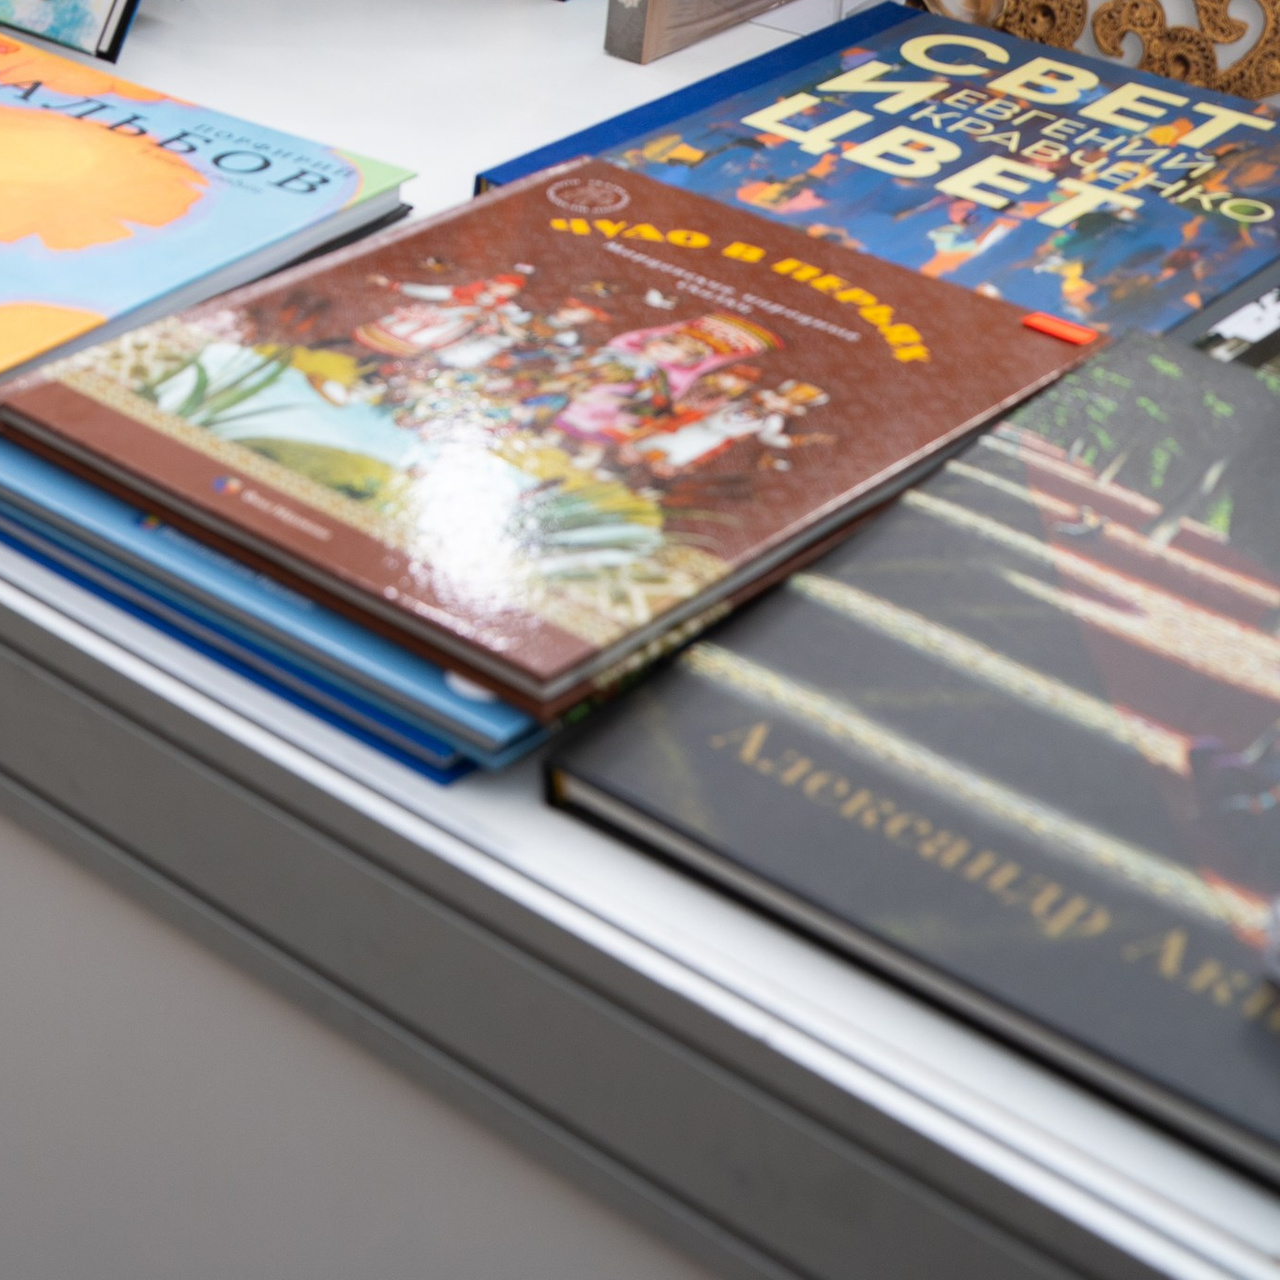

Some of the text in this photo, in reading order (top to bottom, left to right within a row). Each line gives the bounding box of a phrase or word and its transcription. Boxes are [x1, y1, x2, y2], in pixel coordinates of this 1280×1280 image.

[816, 59, 951, 115] И
[900, 33, 1277, 150] СВЕТ
[943, 88, 1217, 178] ЕВГЕНИЙ
[740, 92, 1145, 228] ЦВЕТ
[909, 106, 1276, 224] КРАВЧЕНКО
[549, 216, 712, 250] ЧУДО
[721, 240, 767, 263] В
